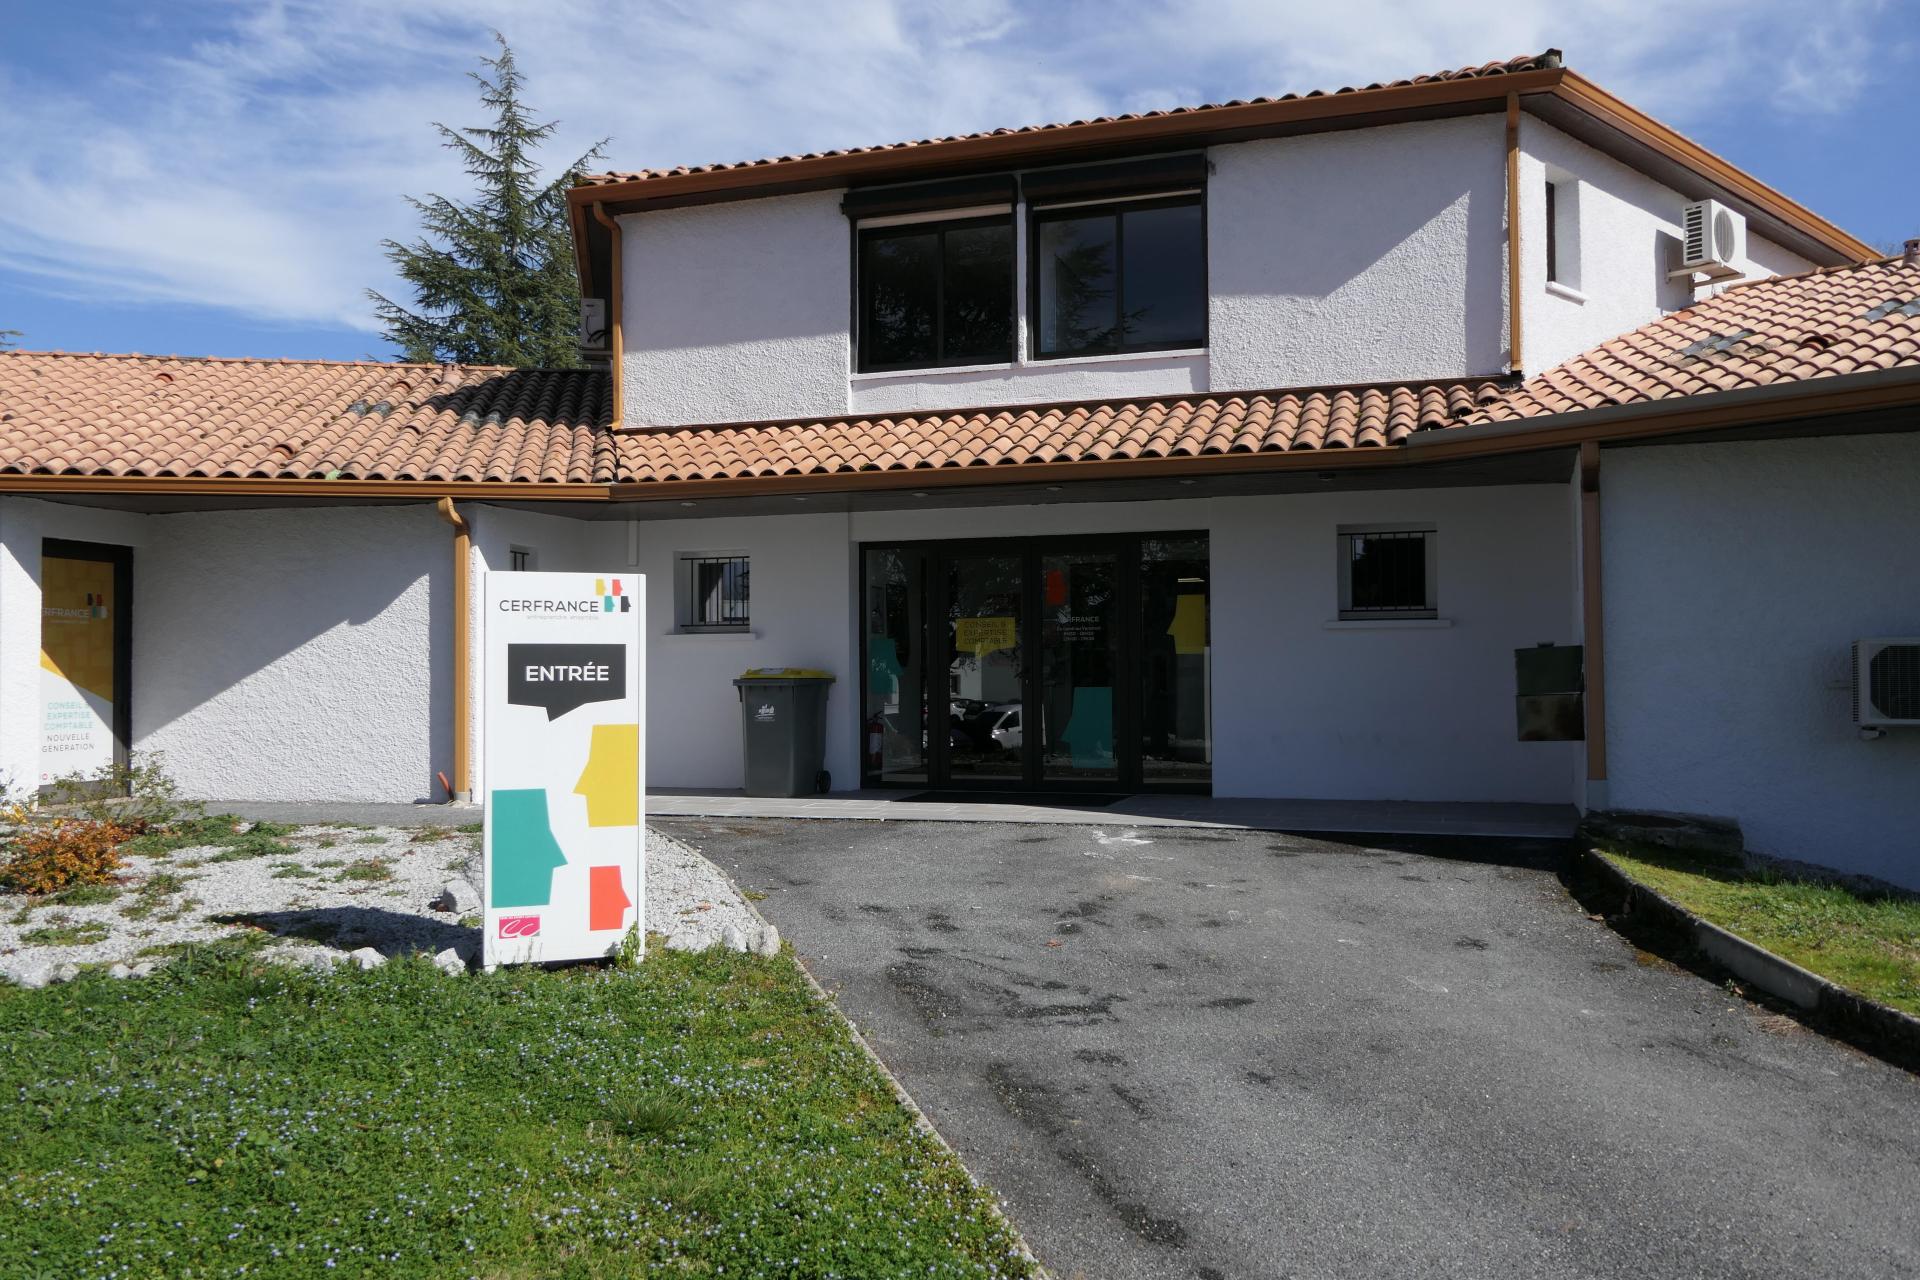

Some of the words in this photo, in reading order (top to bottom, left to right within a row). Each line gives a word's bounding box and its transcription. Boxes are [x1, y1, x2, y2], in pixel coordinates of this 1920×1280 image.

[499, 600, 599, 613] CERFRANCE
[525, 661, 610, 682] ENTRÉE
[47, 711, 91, 720] EXPERTISE
[44, 721, 93, 731] COMPTABLE
[47, 732, 90, 742] NOUVELLE
